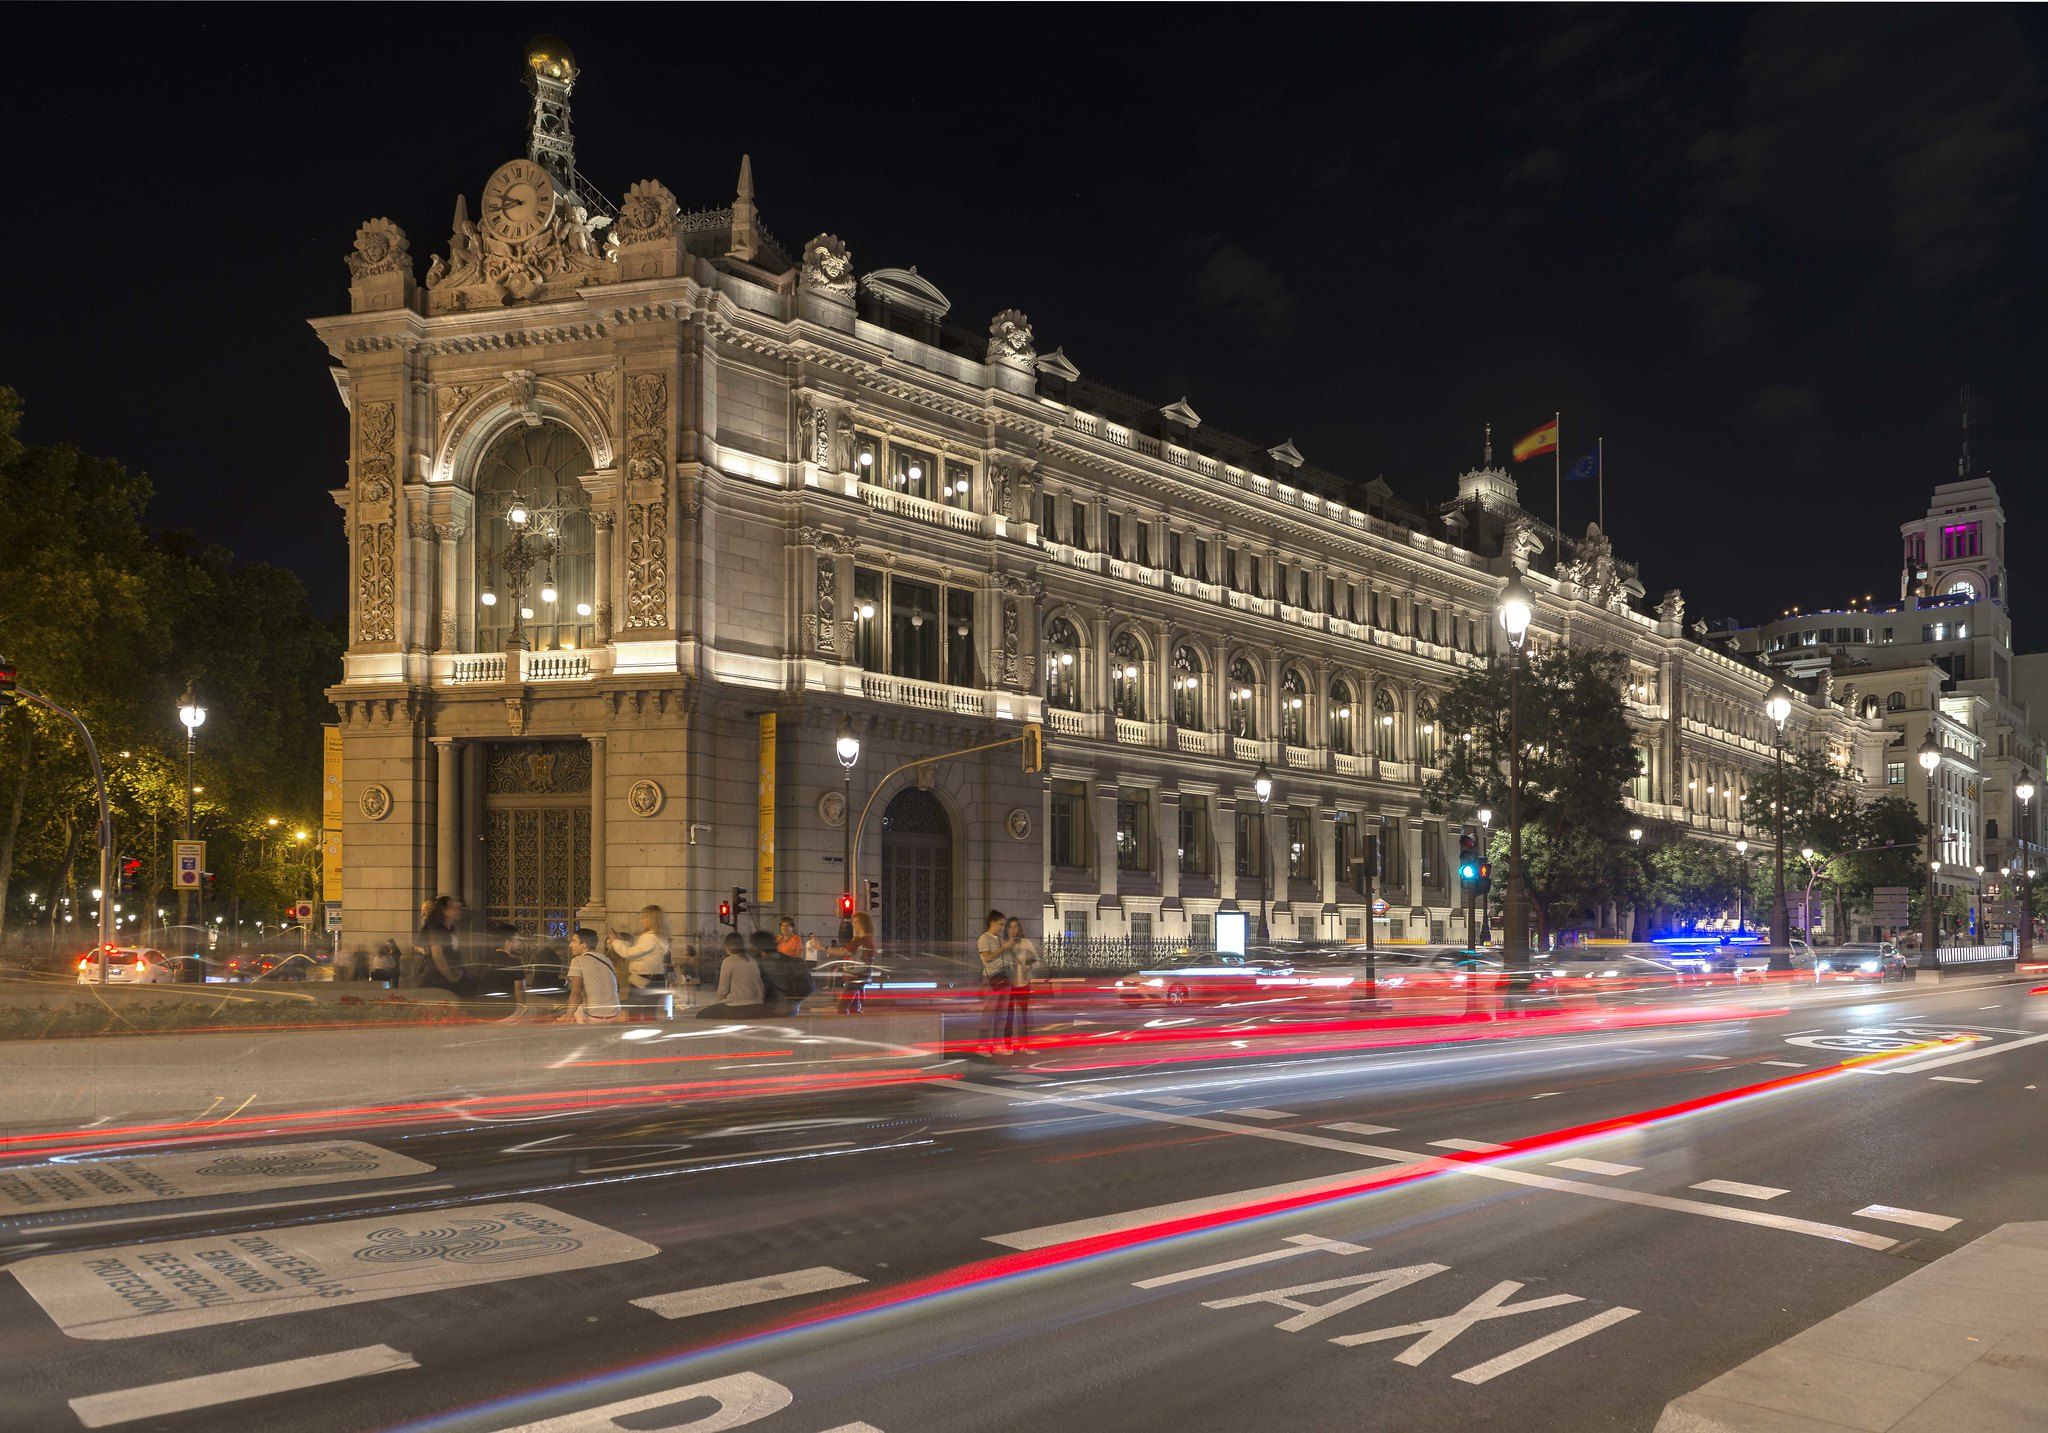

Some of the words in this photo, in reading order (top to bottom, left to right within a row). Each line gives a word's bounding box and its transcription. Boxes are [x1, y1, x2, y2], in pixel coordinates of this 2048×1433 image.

[492, 1210, 572, 1235] MADRID
[137, 1252, 180, 1265] DE
[230, 1236, 285, 1258] ZONA
[193, 1250, 284, 1294] EMISIONES
[263, 1256, 306, 1269] DE
[153, 1264, 234, 1308] ESPECIAL
[282, 1267, 355, 1299] BAJAS
[1131, 1233, 1642, 1386] TAXI
